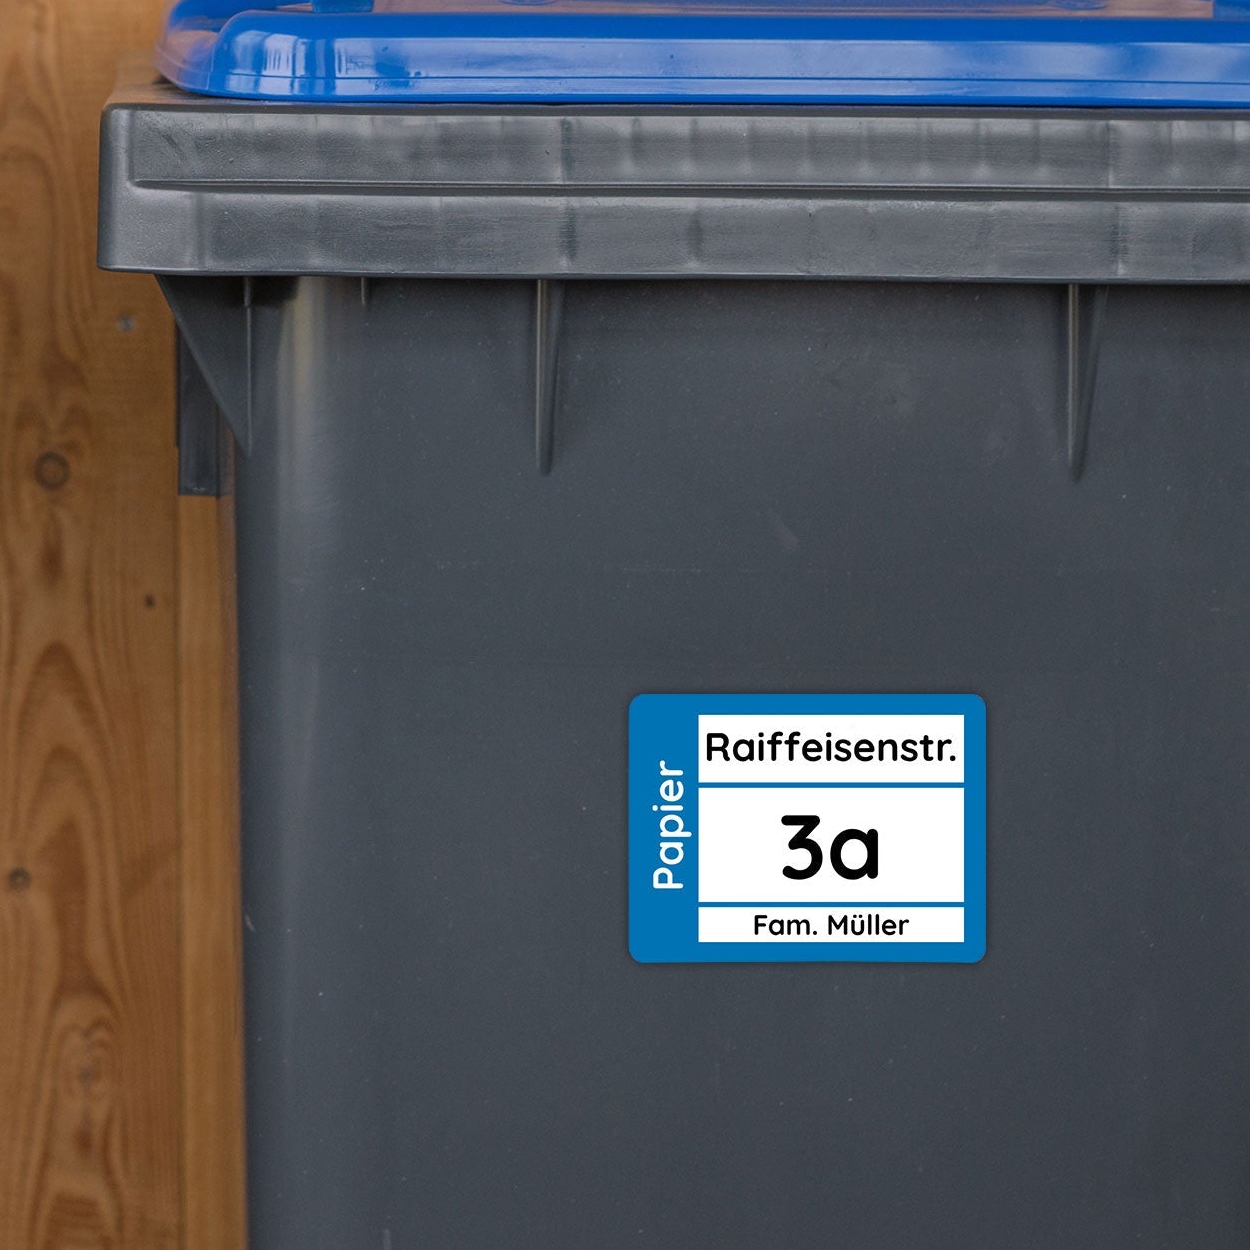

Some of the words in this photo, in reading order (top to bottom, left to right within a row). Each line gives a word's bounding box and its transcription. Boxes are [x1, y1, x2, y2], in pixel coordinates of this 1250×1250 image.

[706, 731, 956, 762] Raiffeisenstr.
[652, 760, 692, 889] Papier
[780, 814, 879, 881] 3a
[754, 914, 818, 936] Fam.
[827, 913, 910, 936] Müller
